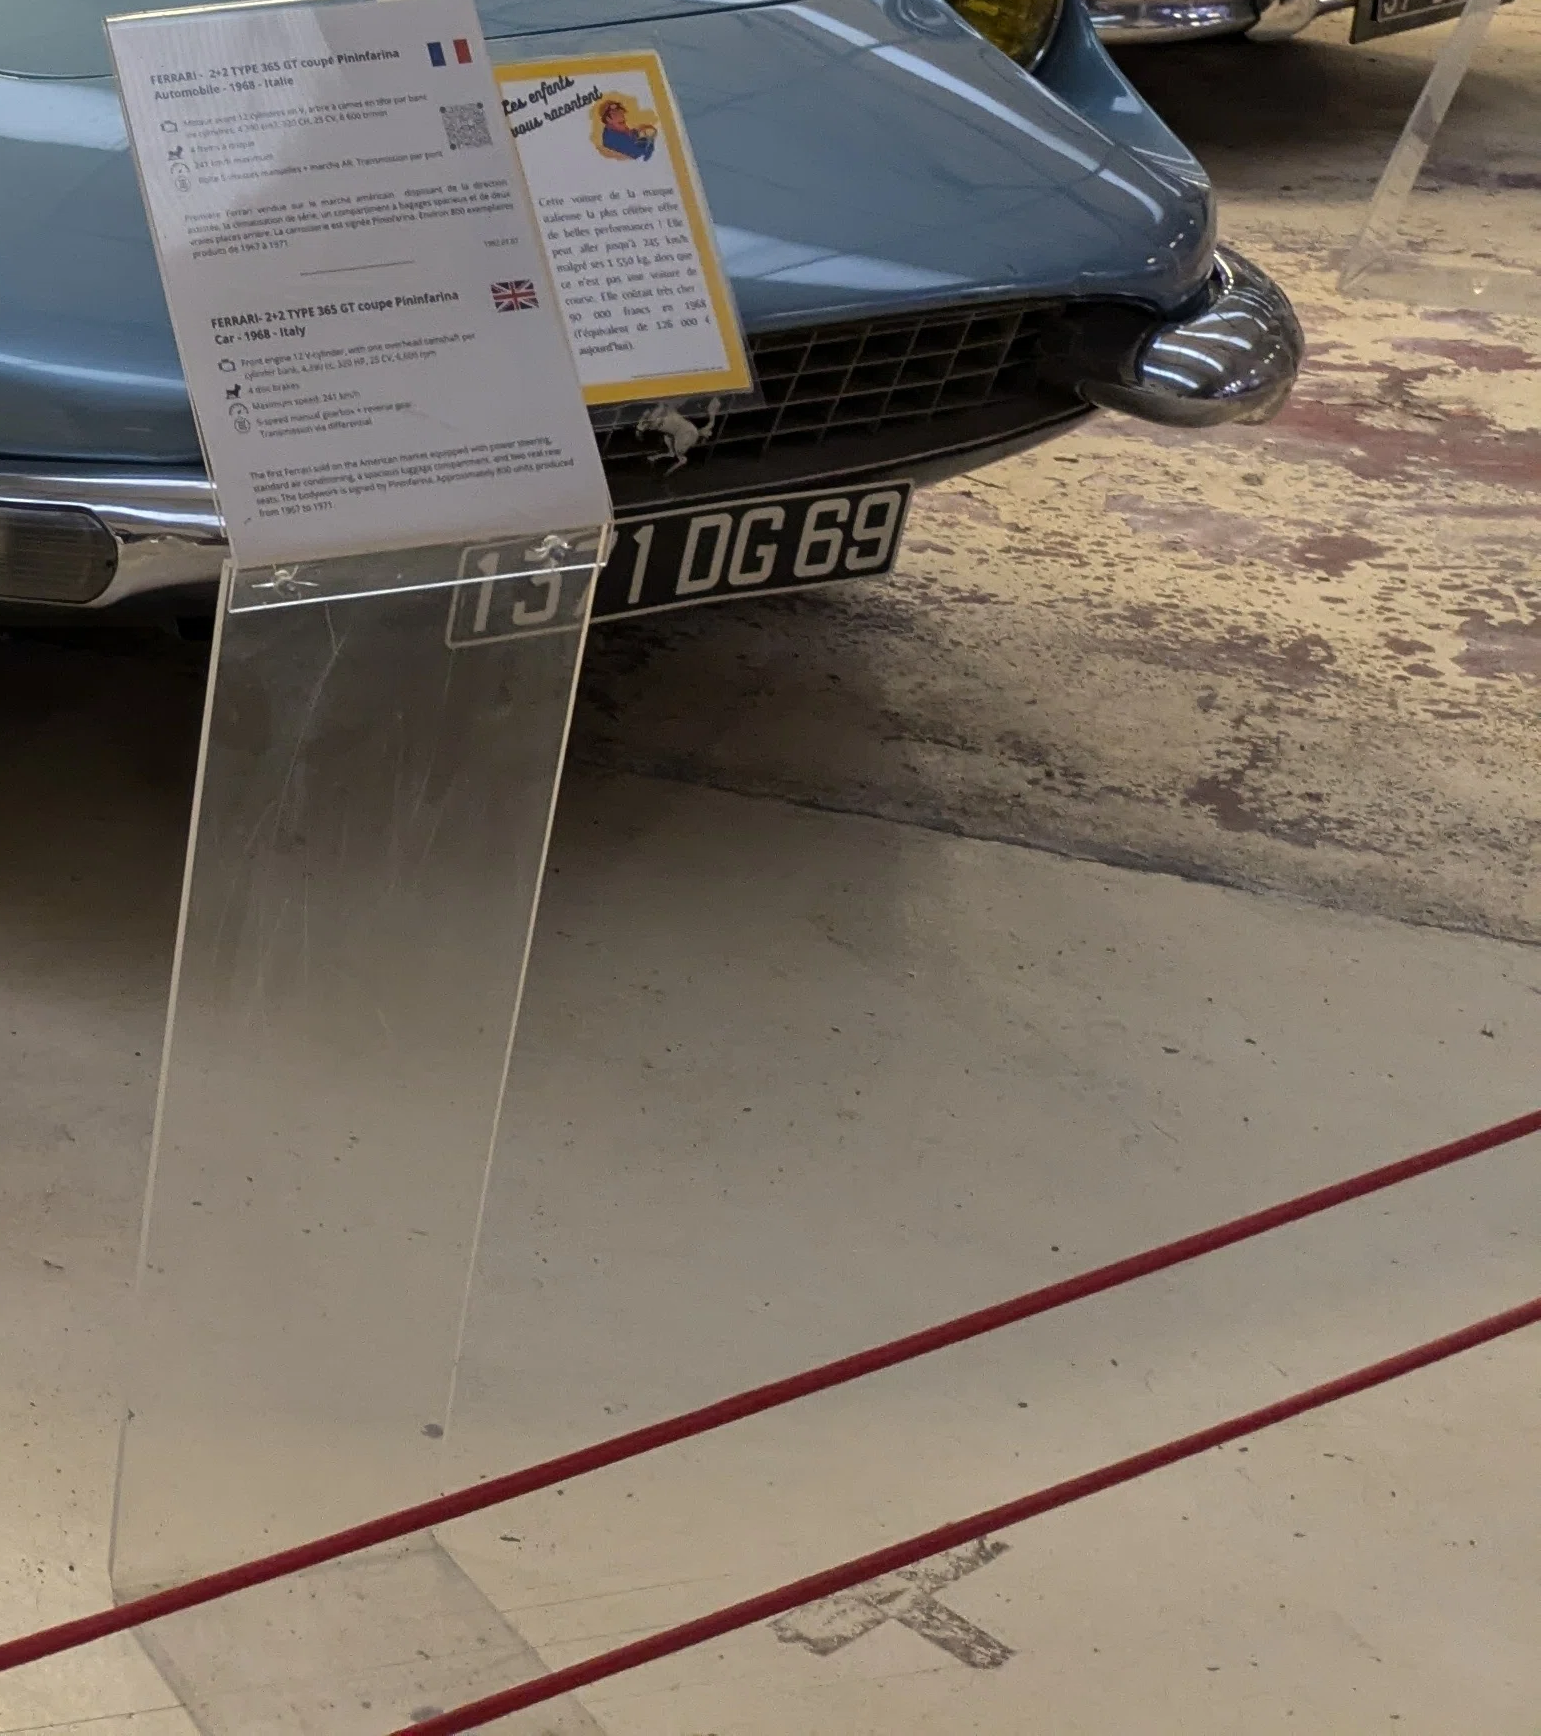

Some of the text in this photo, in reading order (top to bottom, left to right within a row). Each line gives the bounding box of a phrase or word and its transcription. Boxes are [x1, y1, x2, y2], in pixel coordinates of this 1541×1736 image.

[149, 70, 197, 84] FERRARI
[208, 67, 229, 78] 2+2
[230, 63, 259, 76] TYPE
[260, 61, 281, 72] 365
[282, 58, 297, 70] GT
[336, 49, 399, 63] Pininfarina
[154, 84, 220, 100] Automobile
[228, 79, 255, 92] 1968
[263, 76, 293, 88] Italie
[529, 75, 574, 104] enfants
[510, 85, 603, 138] vous racontent
[579, 242, 598, 253] aller
[560, 280, 571, 289] ce
[605, 275, 622, 286] pas
[210, 291, 459, 328] FERRARI- 2+2 TYPE 365 GT coupe Pininfarina
[592, 309, 611, 319] 000
[661, 304, 673, 312] en
[679, 317, 698, 327] 000
[214, 334, 234, 345] Car
[243, 328, 271, 341] 1968
[279, 325, 305, 337] Italy
[675, 506, 785, 595] DG
[793, 490, 901, 579] 69
